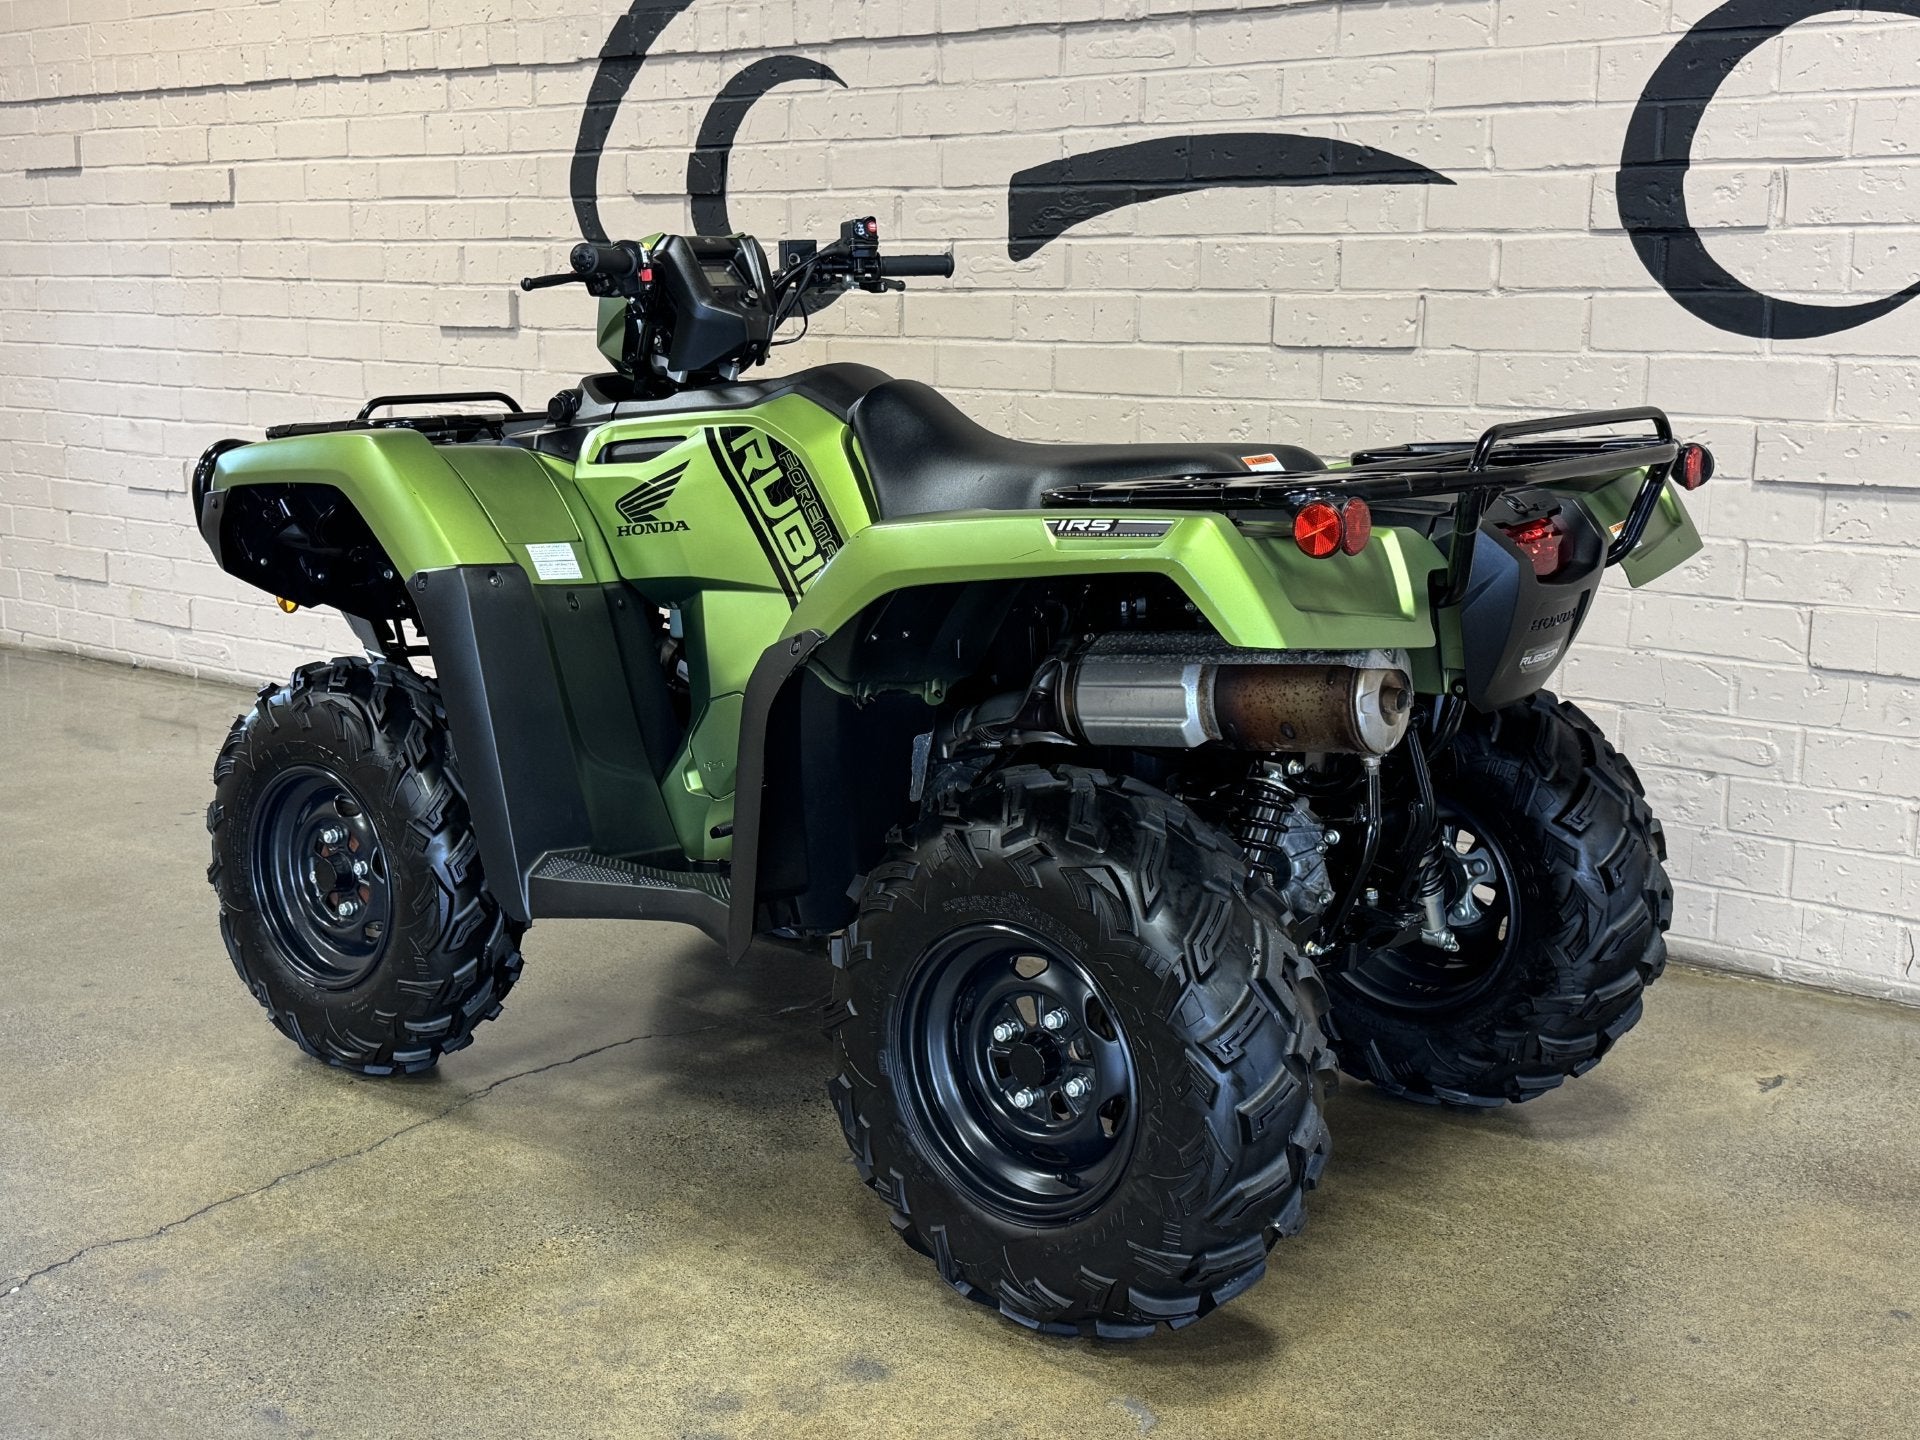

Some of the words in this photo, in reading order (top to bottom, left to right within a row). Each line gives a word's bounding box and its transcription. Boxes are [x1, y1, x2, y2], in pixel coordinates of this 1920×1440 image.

[731, 428, 825, 594] RUBI
[616, 520, 691, 537] HONDA
[1057, 519, 1114, 531] IRS
